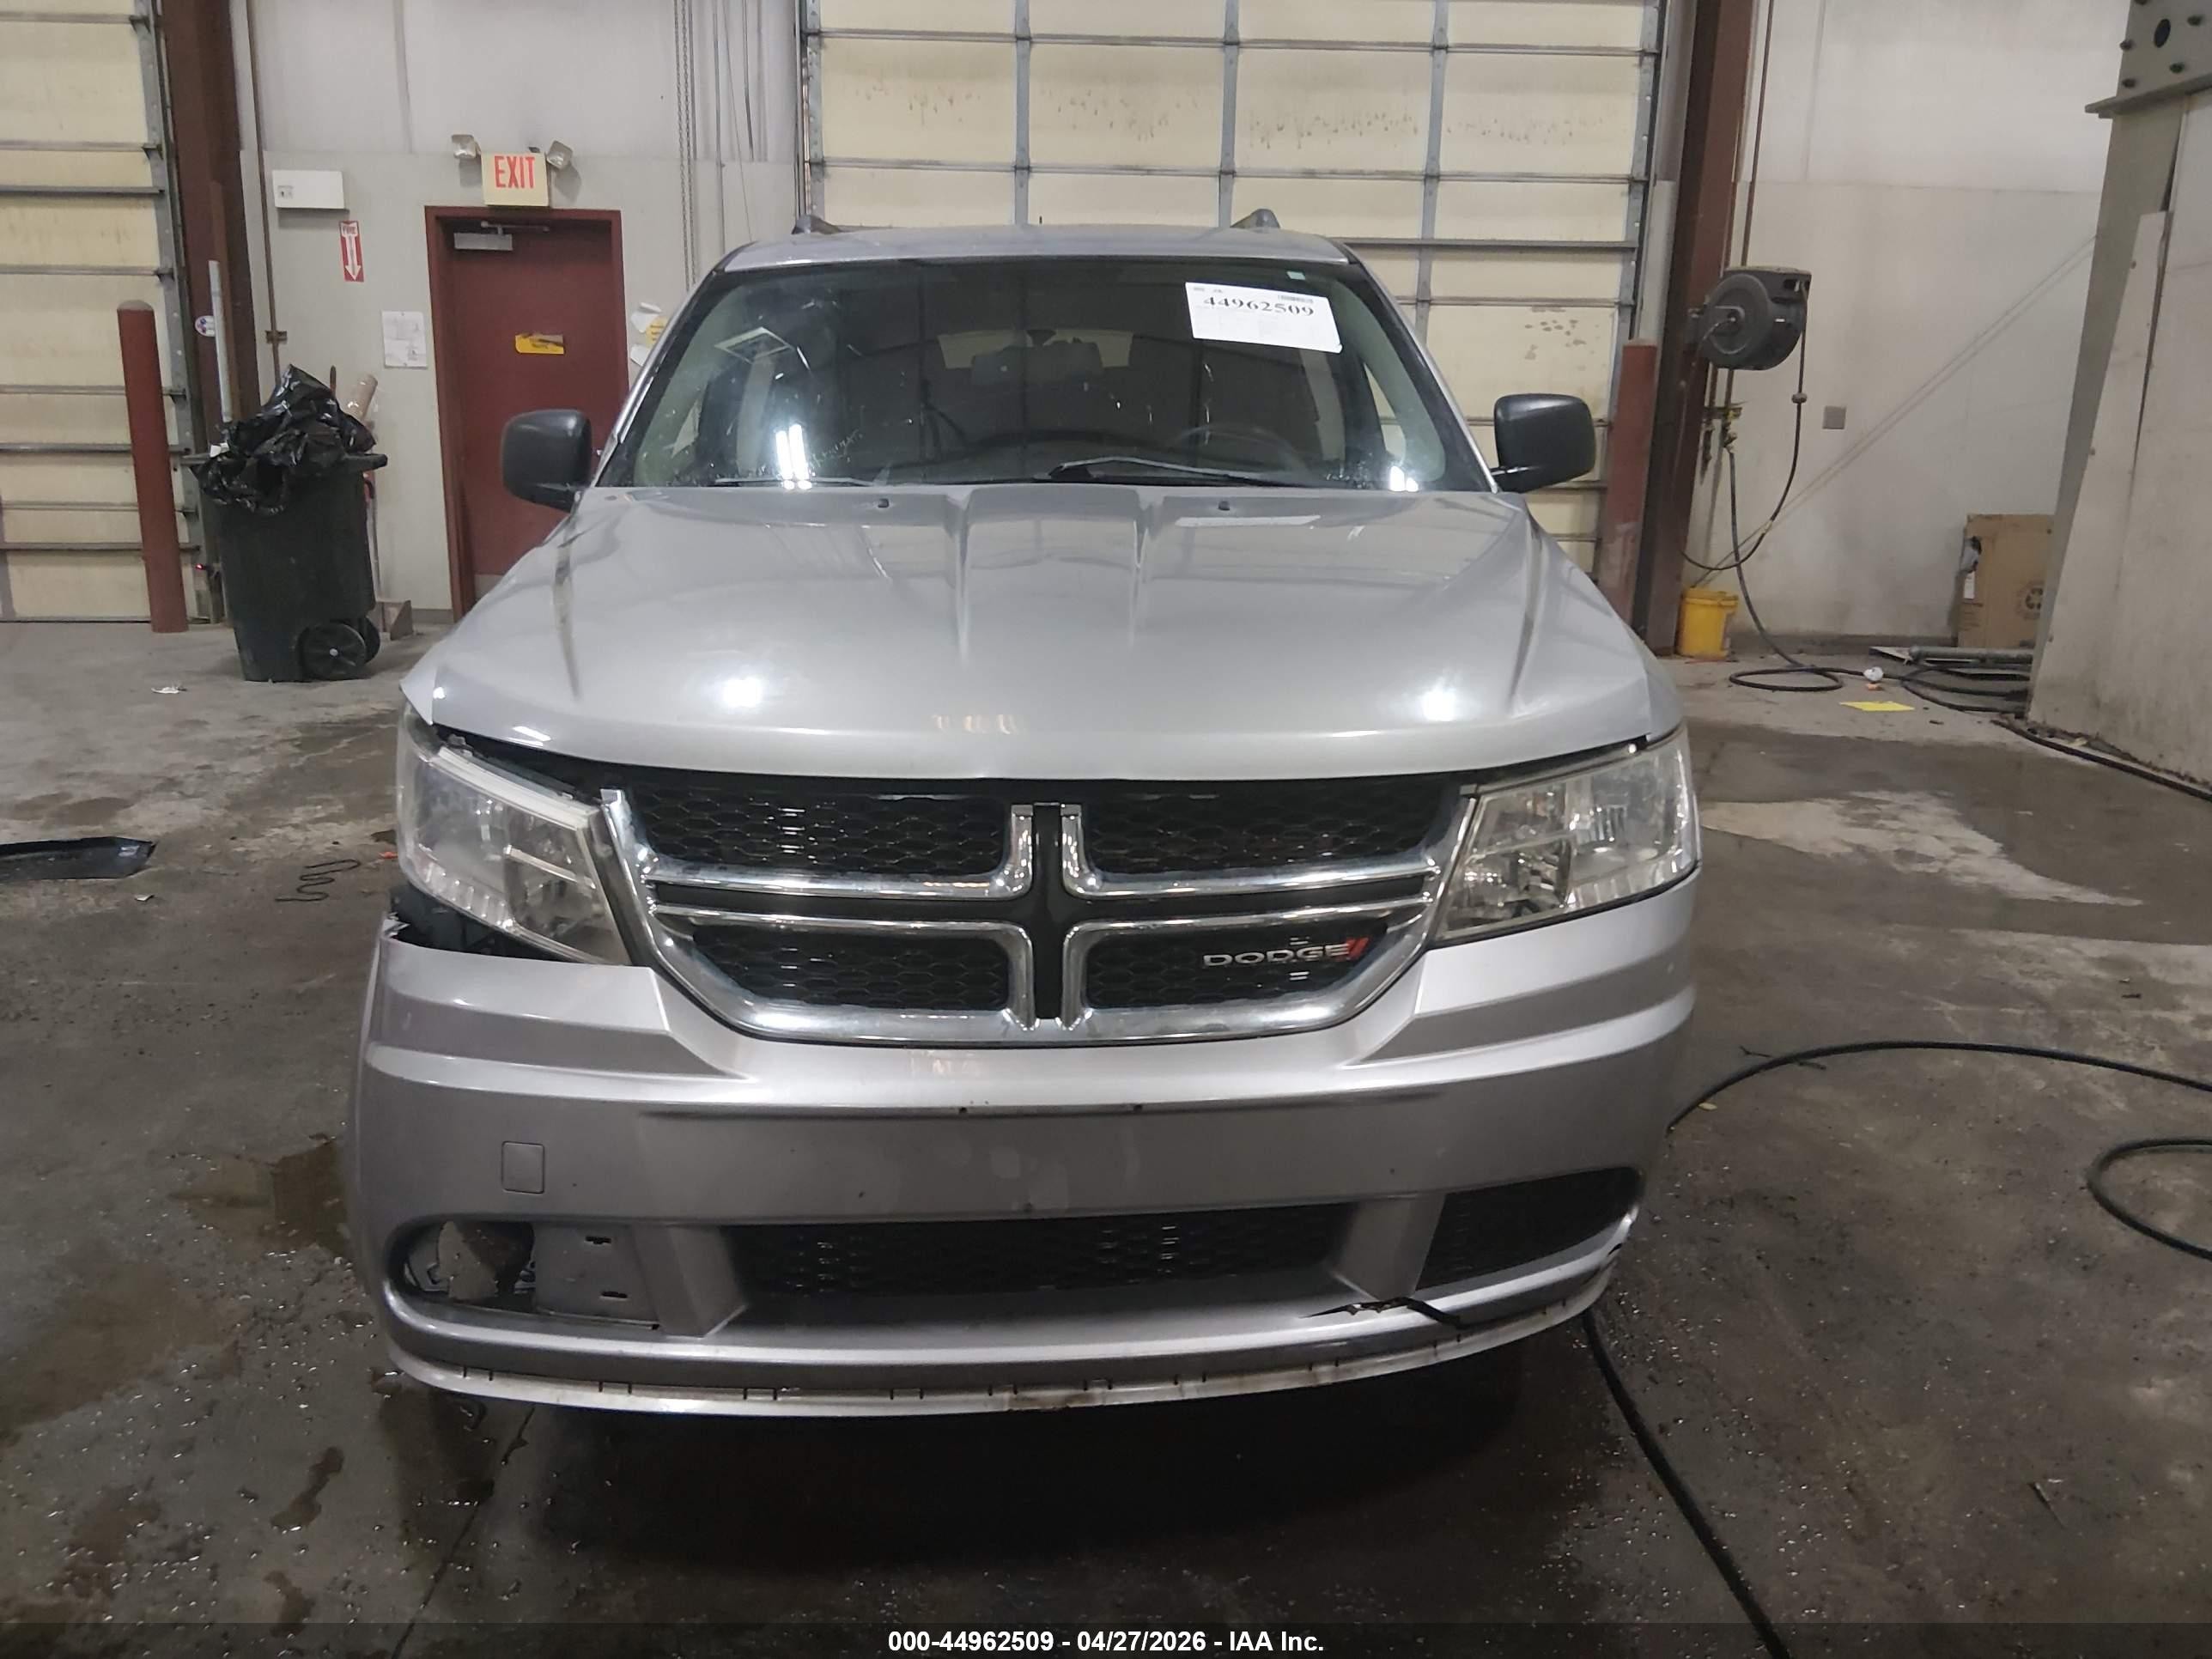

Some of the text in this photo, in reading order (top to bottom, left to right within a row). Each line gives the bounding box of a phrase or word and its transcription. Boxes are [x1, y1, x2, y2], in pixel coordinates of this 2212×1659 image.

[494, 155, 535, 189] EXIT
[1203, 296, 1314, 315] 44962509
[1203, 944, 1349, 966] DODGE
